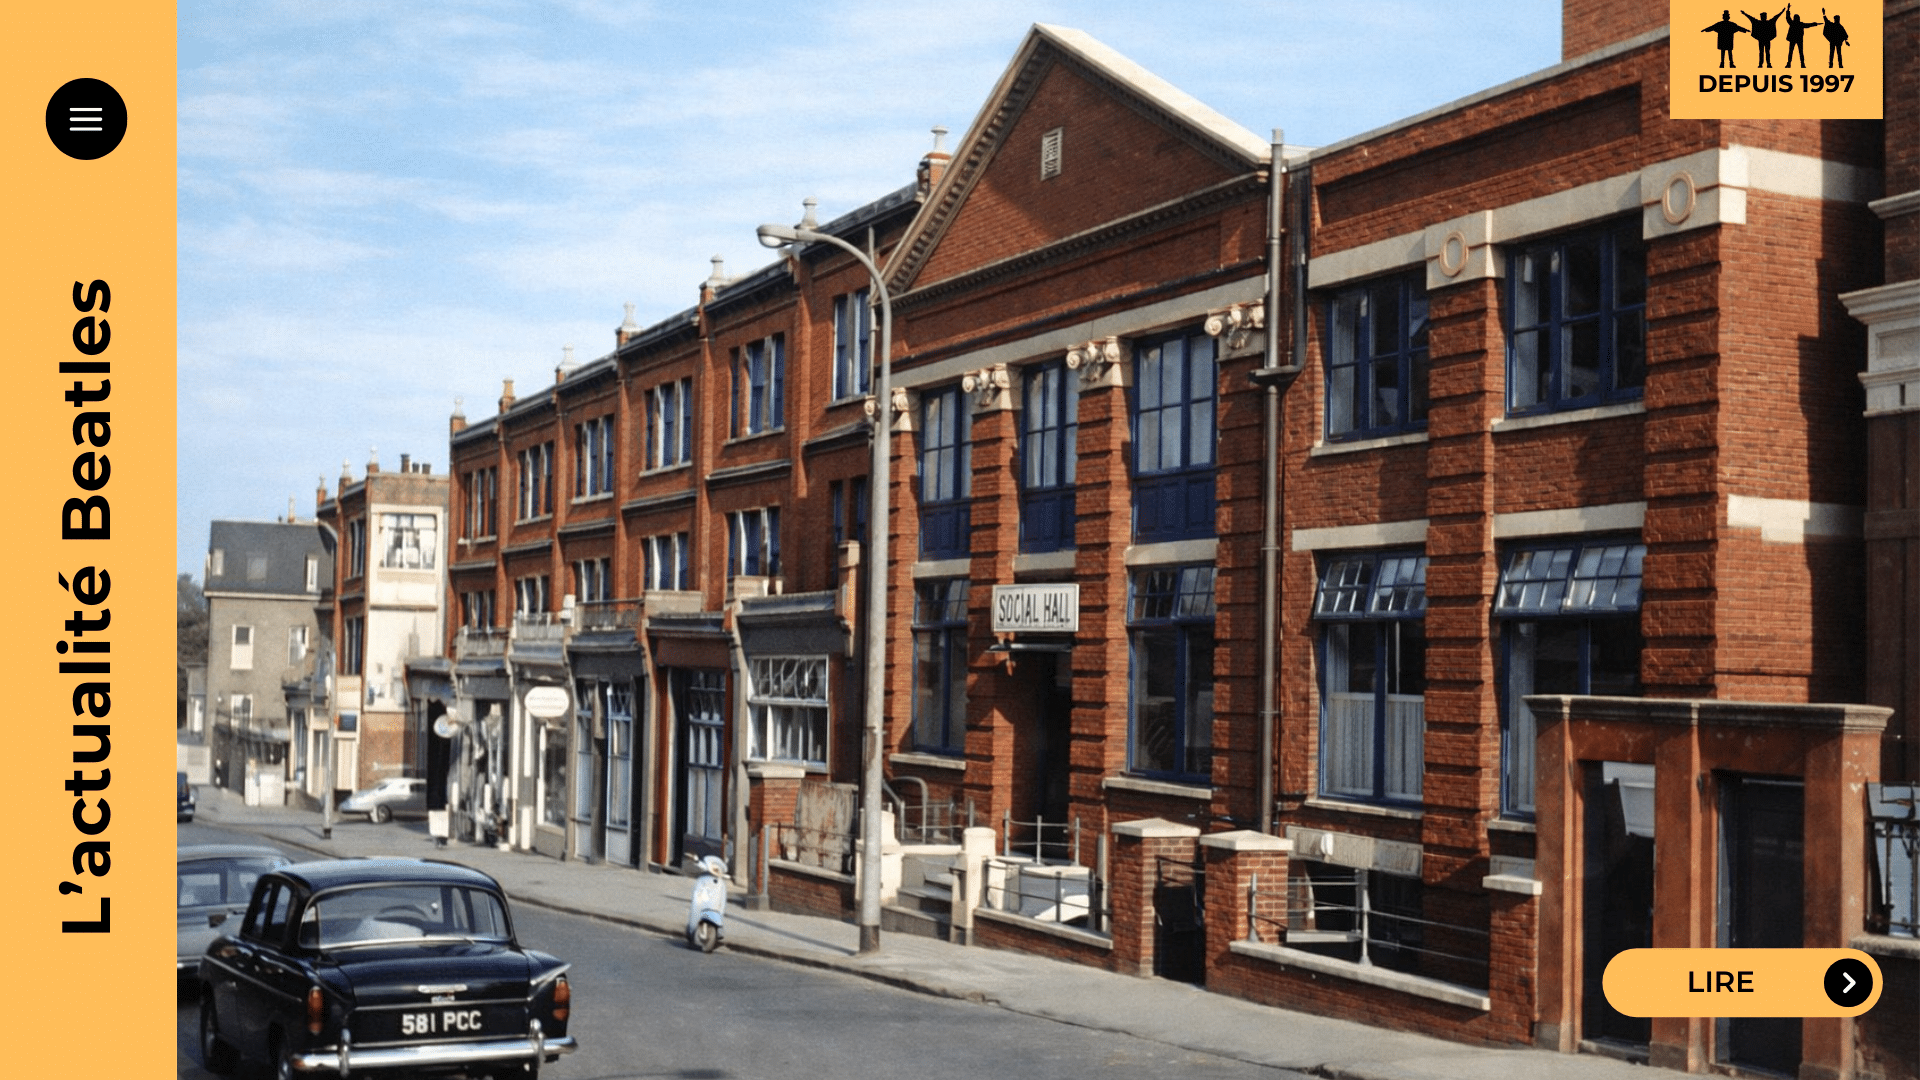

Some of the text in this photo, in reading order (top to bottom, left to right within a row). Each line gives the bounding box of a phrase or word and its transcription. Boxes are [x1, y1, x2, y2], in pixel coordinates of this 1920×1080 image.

[999, 592, 1070, 623] SOCIAL HALL
[402, 1010, 482, 1035] 581 PCC
